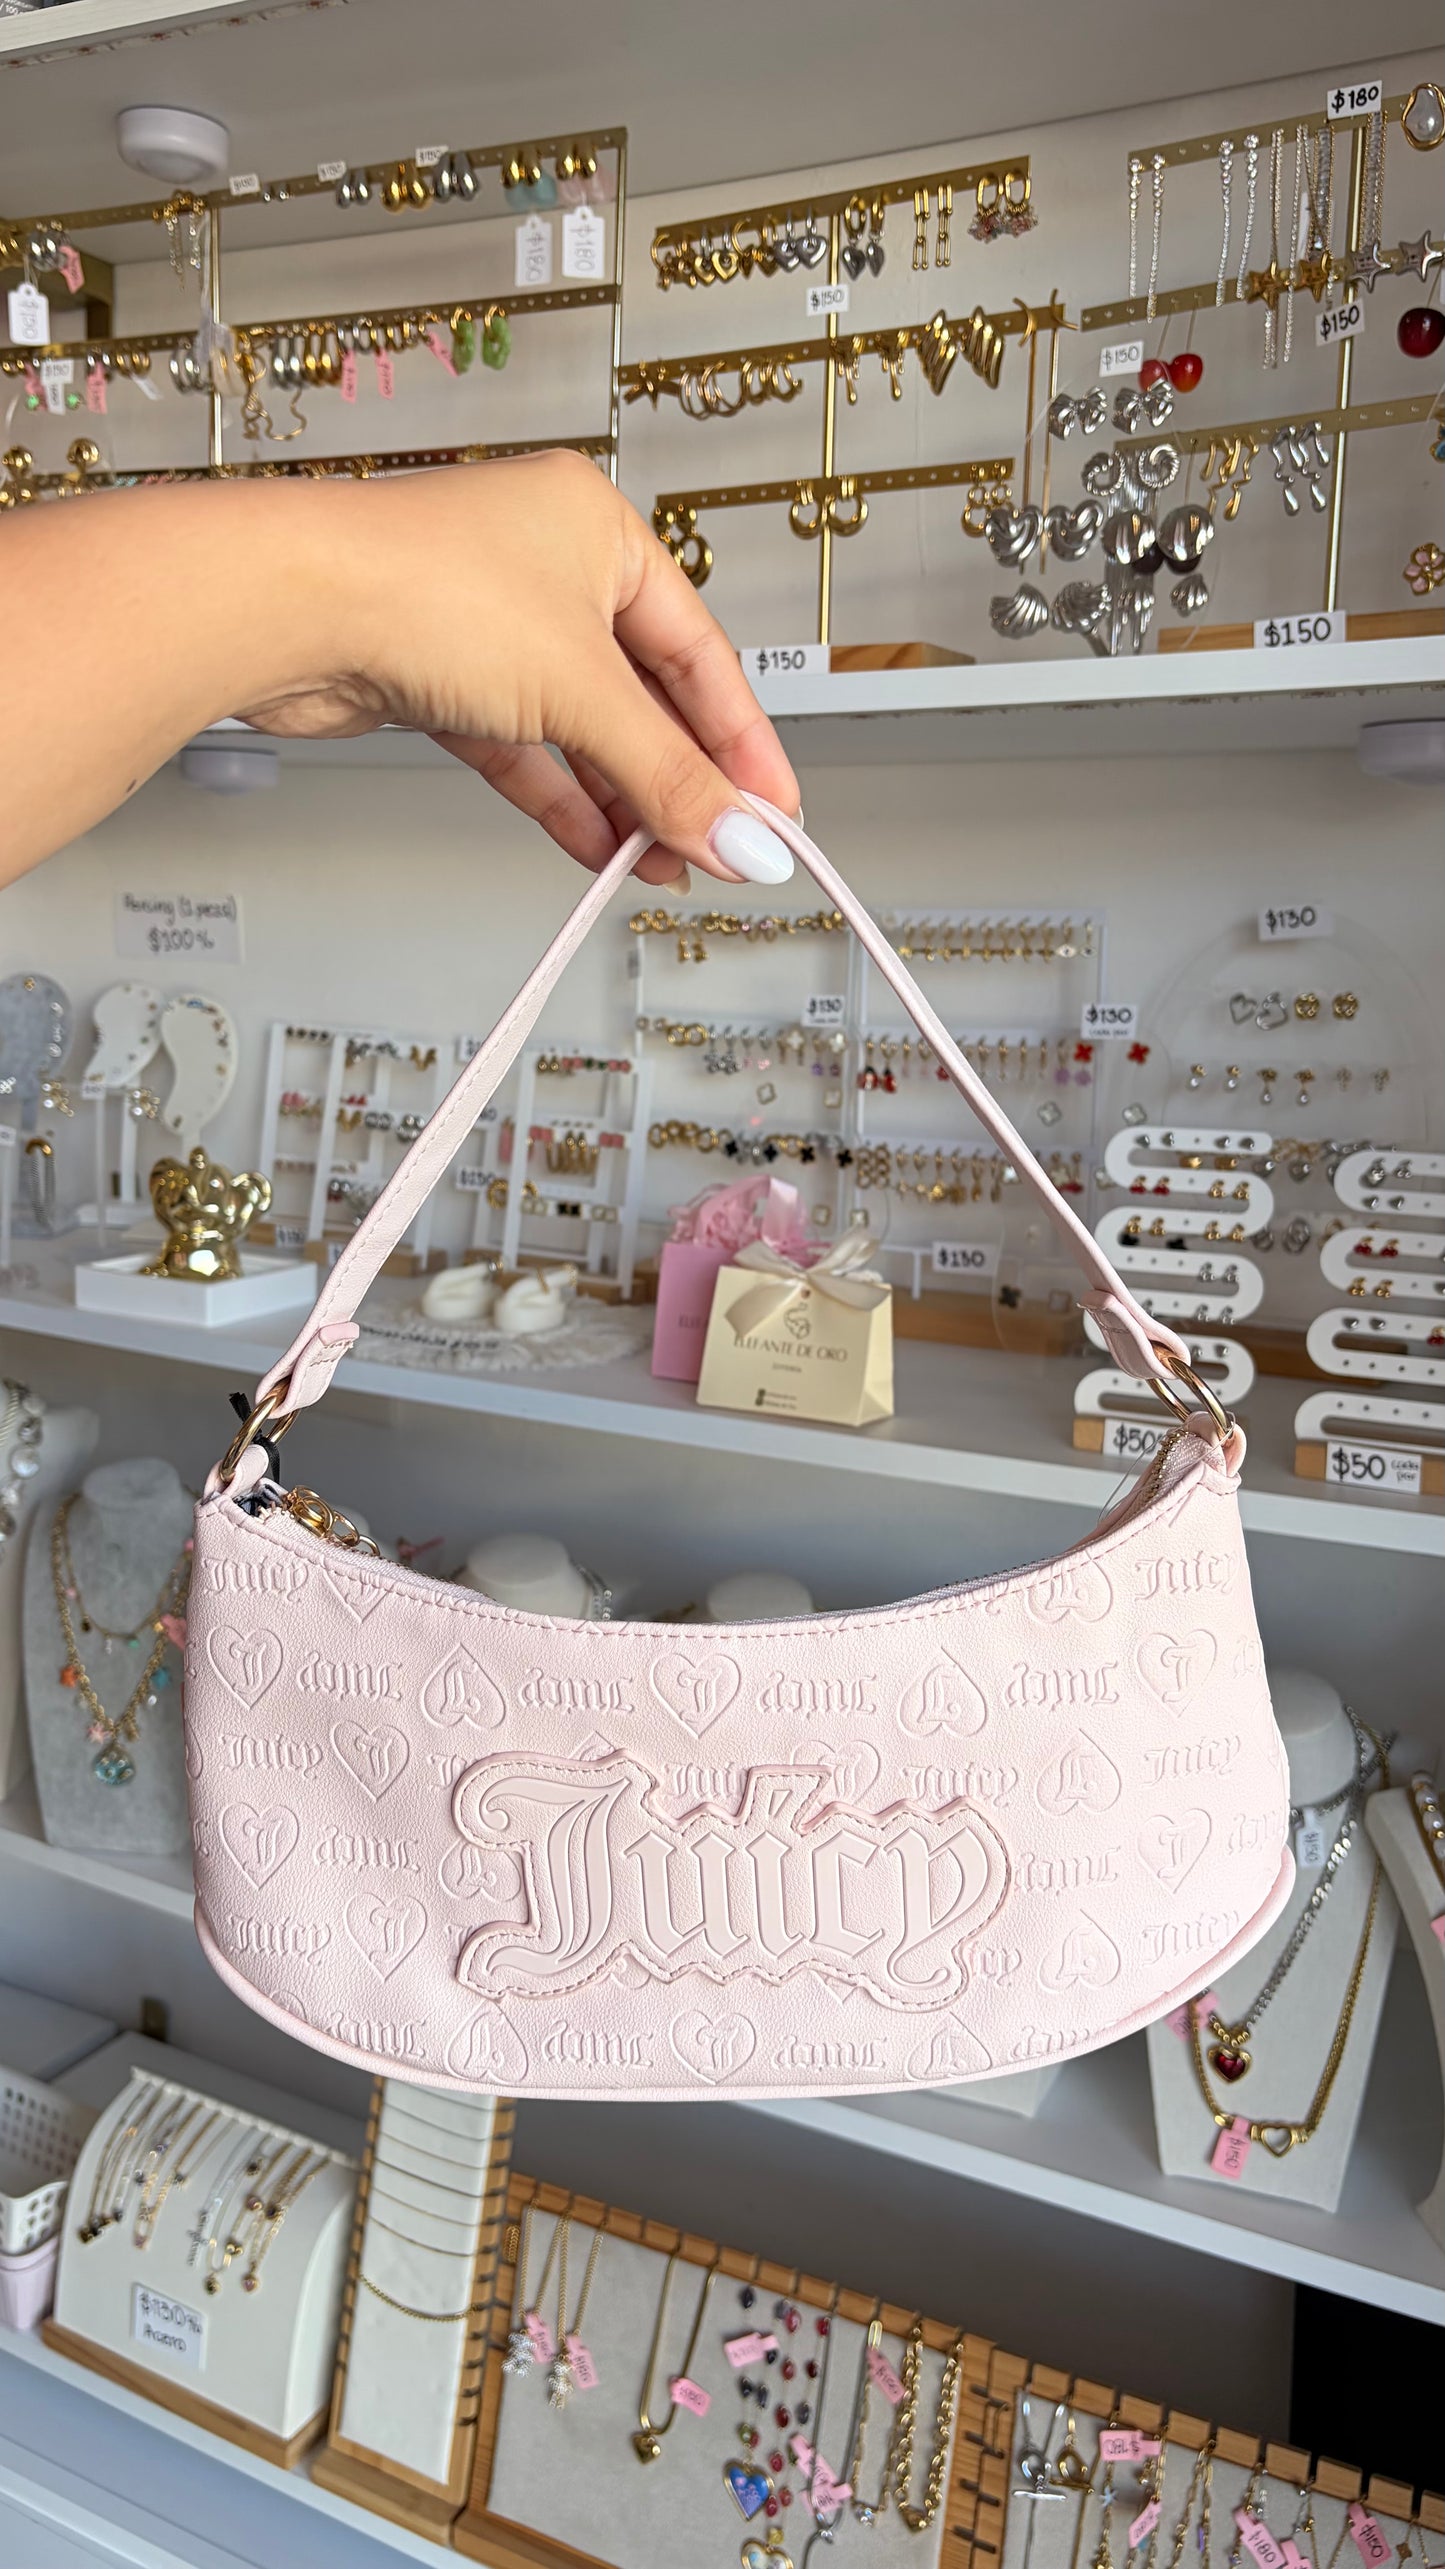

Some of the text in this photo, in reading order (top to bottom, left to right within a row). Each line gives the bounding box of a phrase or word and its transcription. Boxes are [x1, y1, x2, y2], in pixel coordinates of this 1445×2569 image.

[1332, 86, 1379, 113] $180
[569, 225, 597, 273] $180
[1320, 304, 1360, 341] $150
[1102, 346, 1140, 372] $150
[1264, 617, 1332, 647] $150
[755, 647, 807, 676] $150
[1265, 905, 1318, 936] $130
[1085, 1002, 1134, 1025] $130
[796, 1345, 816, 1359] DE
[816, 1346, 848, 1363] ORO
[1113, 1422, 1157, 1455] $50
[1331, 1445, 1386, 1482] $50
[203, 1556, 310, 1602] Juicy
[1133, 1550, 1237, 1602] Juicy
[297, 1651, 402, 1701] Juicy
[518, 1667, 636, 1714] Juicy
[757, 1670, 877, 1720] Juicy
[1005, 1660, 1120, 1712] Juicy
[219, 1733, 324, 1780] Juicy
[1143, 1735, 1241, 1786] Juicy
[313, 1824, 421, 1874] Juicy
[486, 1775, 992, 1984] Juicy
[228, 1913, 332, 1966] Juicy
[542, 2019, 655, 2070] Juicy
[773, 2033, 888, 2072] Juicy
[1248, 2530, 1276, 2564] $180
[1358, 2523, 1384, 2558] $150
